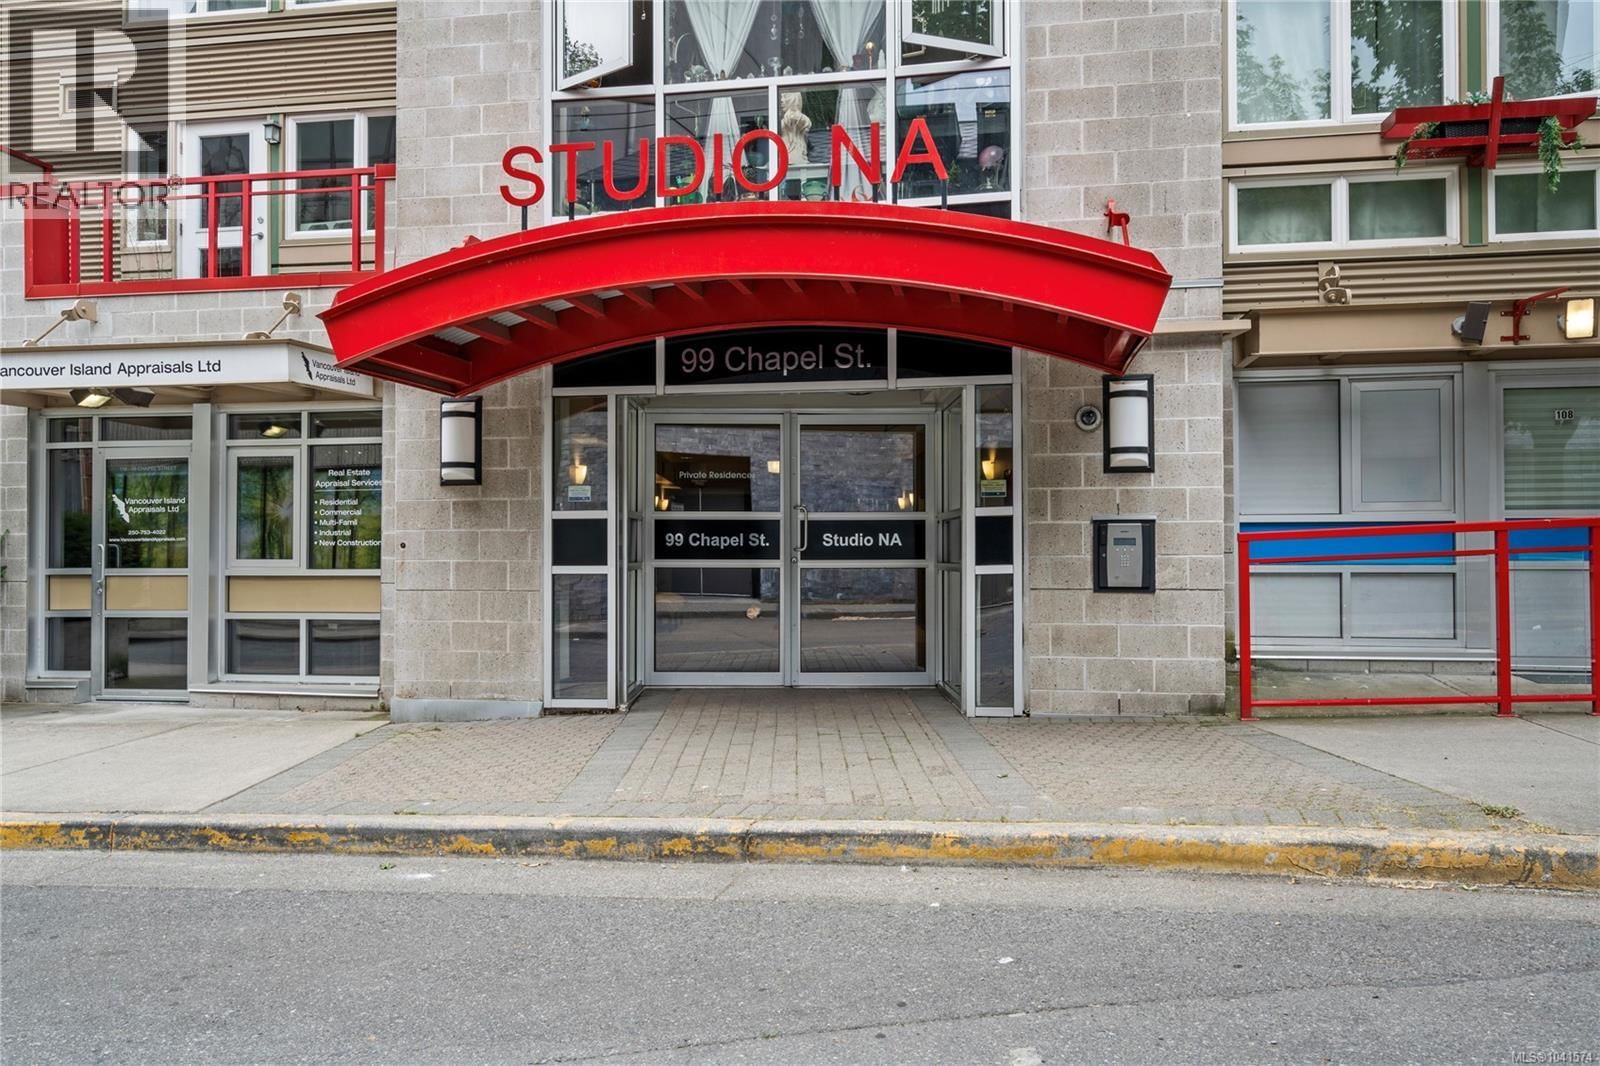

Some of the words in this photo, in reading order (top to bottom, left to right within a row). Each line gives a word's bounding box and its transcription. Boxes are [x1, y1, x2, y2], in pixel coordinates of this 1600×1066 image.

[499, 128, 789, 207] STUDIO
[831, 117, 949, 188] NA
[681, 347, 715, 373] 99
[724, 343, 823, 376] Chapel
[834, 342, 872, 369] St.
[70, 362, 112, 377] Island
[117, 360, 194, 378] Appraisals
[198, 359, 222, 373] Ltd
[315, 371, 346, 385] Appraisals
[346, 377, 356, 386] Ltd
[1555, 409, 1574, 419] 108
[679, 471, 707, 479] Private
[315, 480, 350, 489] Appraisal
[124, 497, 163, 505] Vancouver
[128, 506, 166, 514] Appraisals
[319, 529, 352, 537] Industrial
[665, 533, 684, 547] 99
[688, 532, 744, 550] Chapel
[748, 532, 770, 547] St.
[822, 532, 874, 547] Studio
[878, 533, 902, 546] NA
